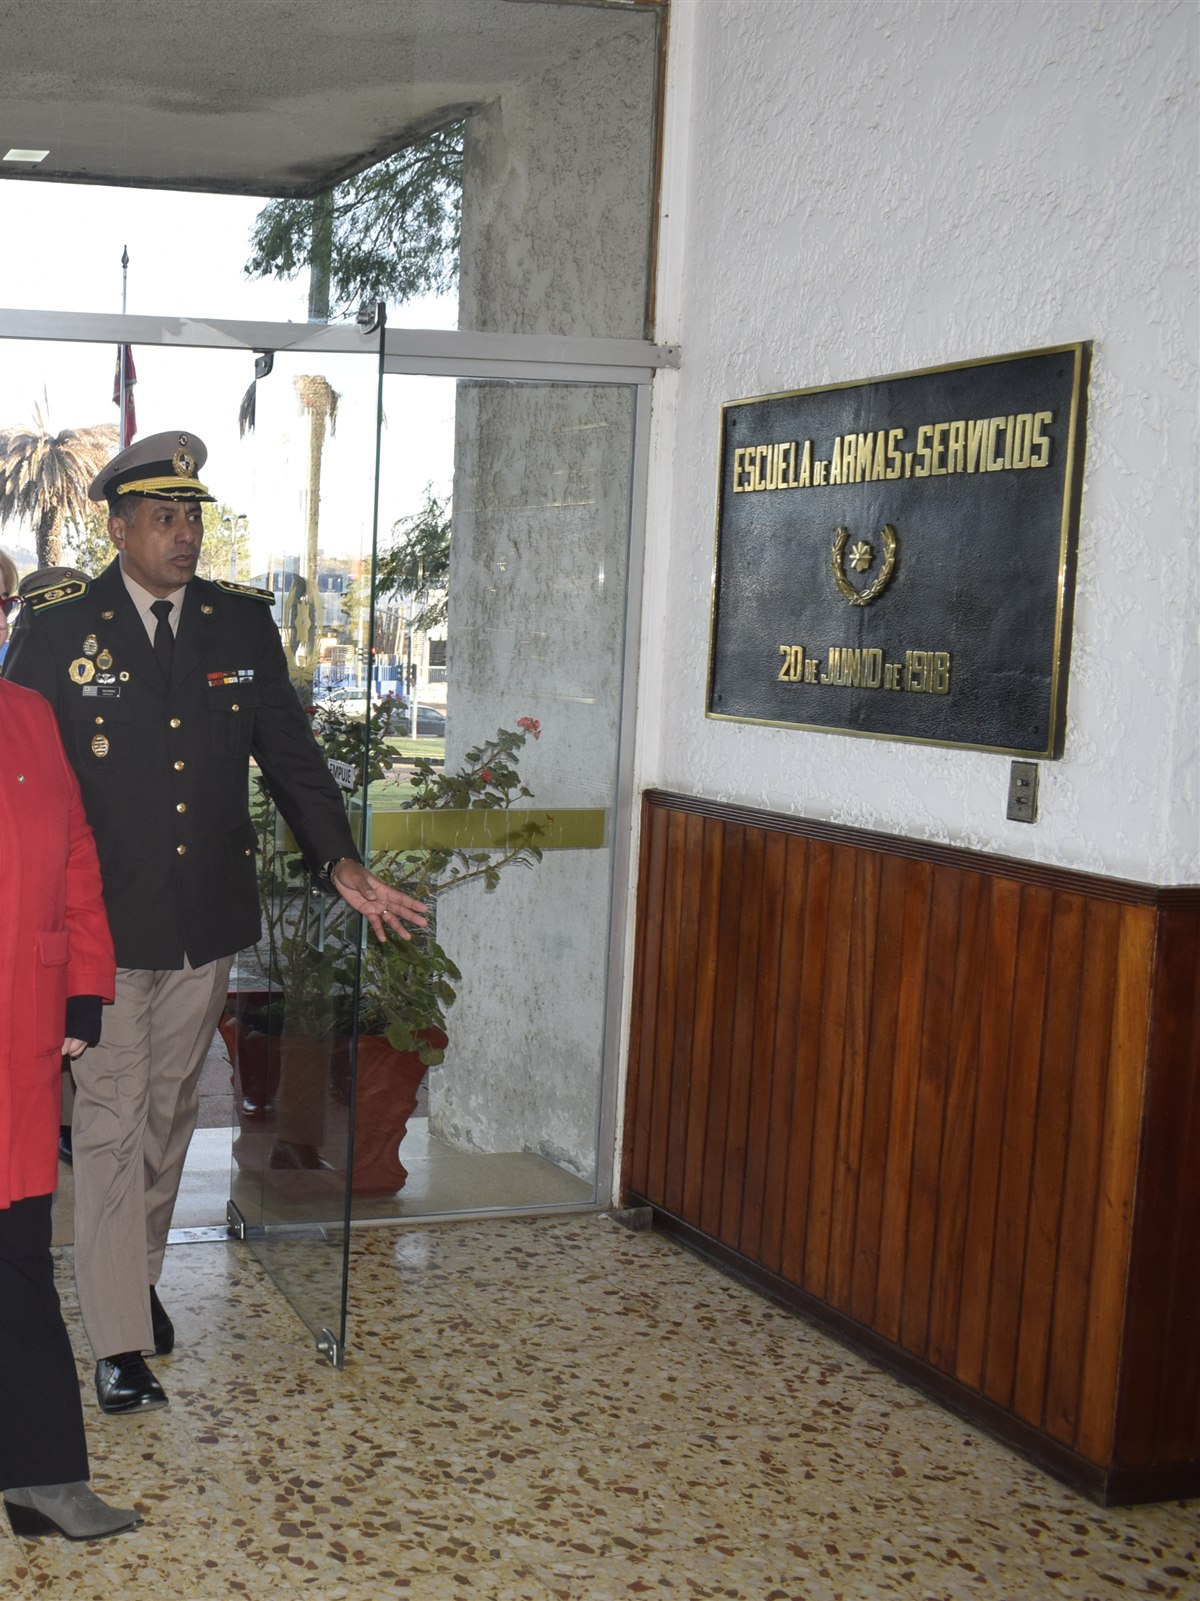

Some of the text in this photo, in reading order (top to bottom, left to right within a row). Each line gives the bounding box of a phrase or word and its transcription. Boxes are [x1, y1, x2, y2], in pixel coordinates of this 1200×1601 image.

[733, 412, 1053, 492] ESCUELA DE ARMAS Y SERVICIOS
[777, 645, 950, 694] 20 DE JUNIO DE 1918
